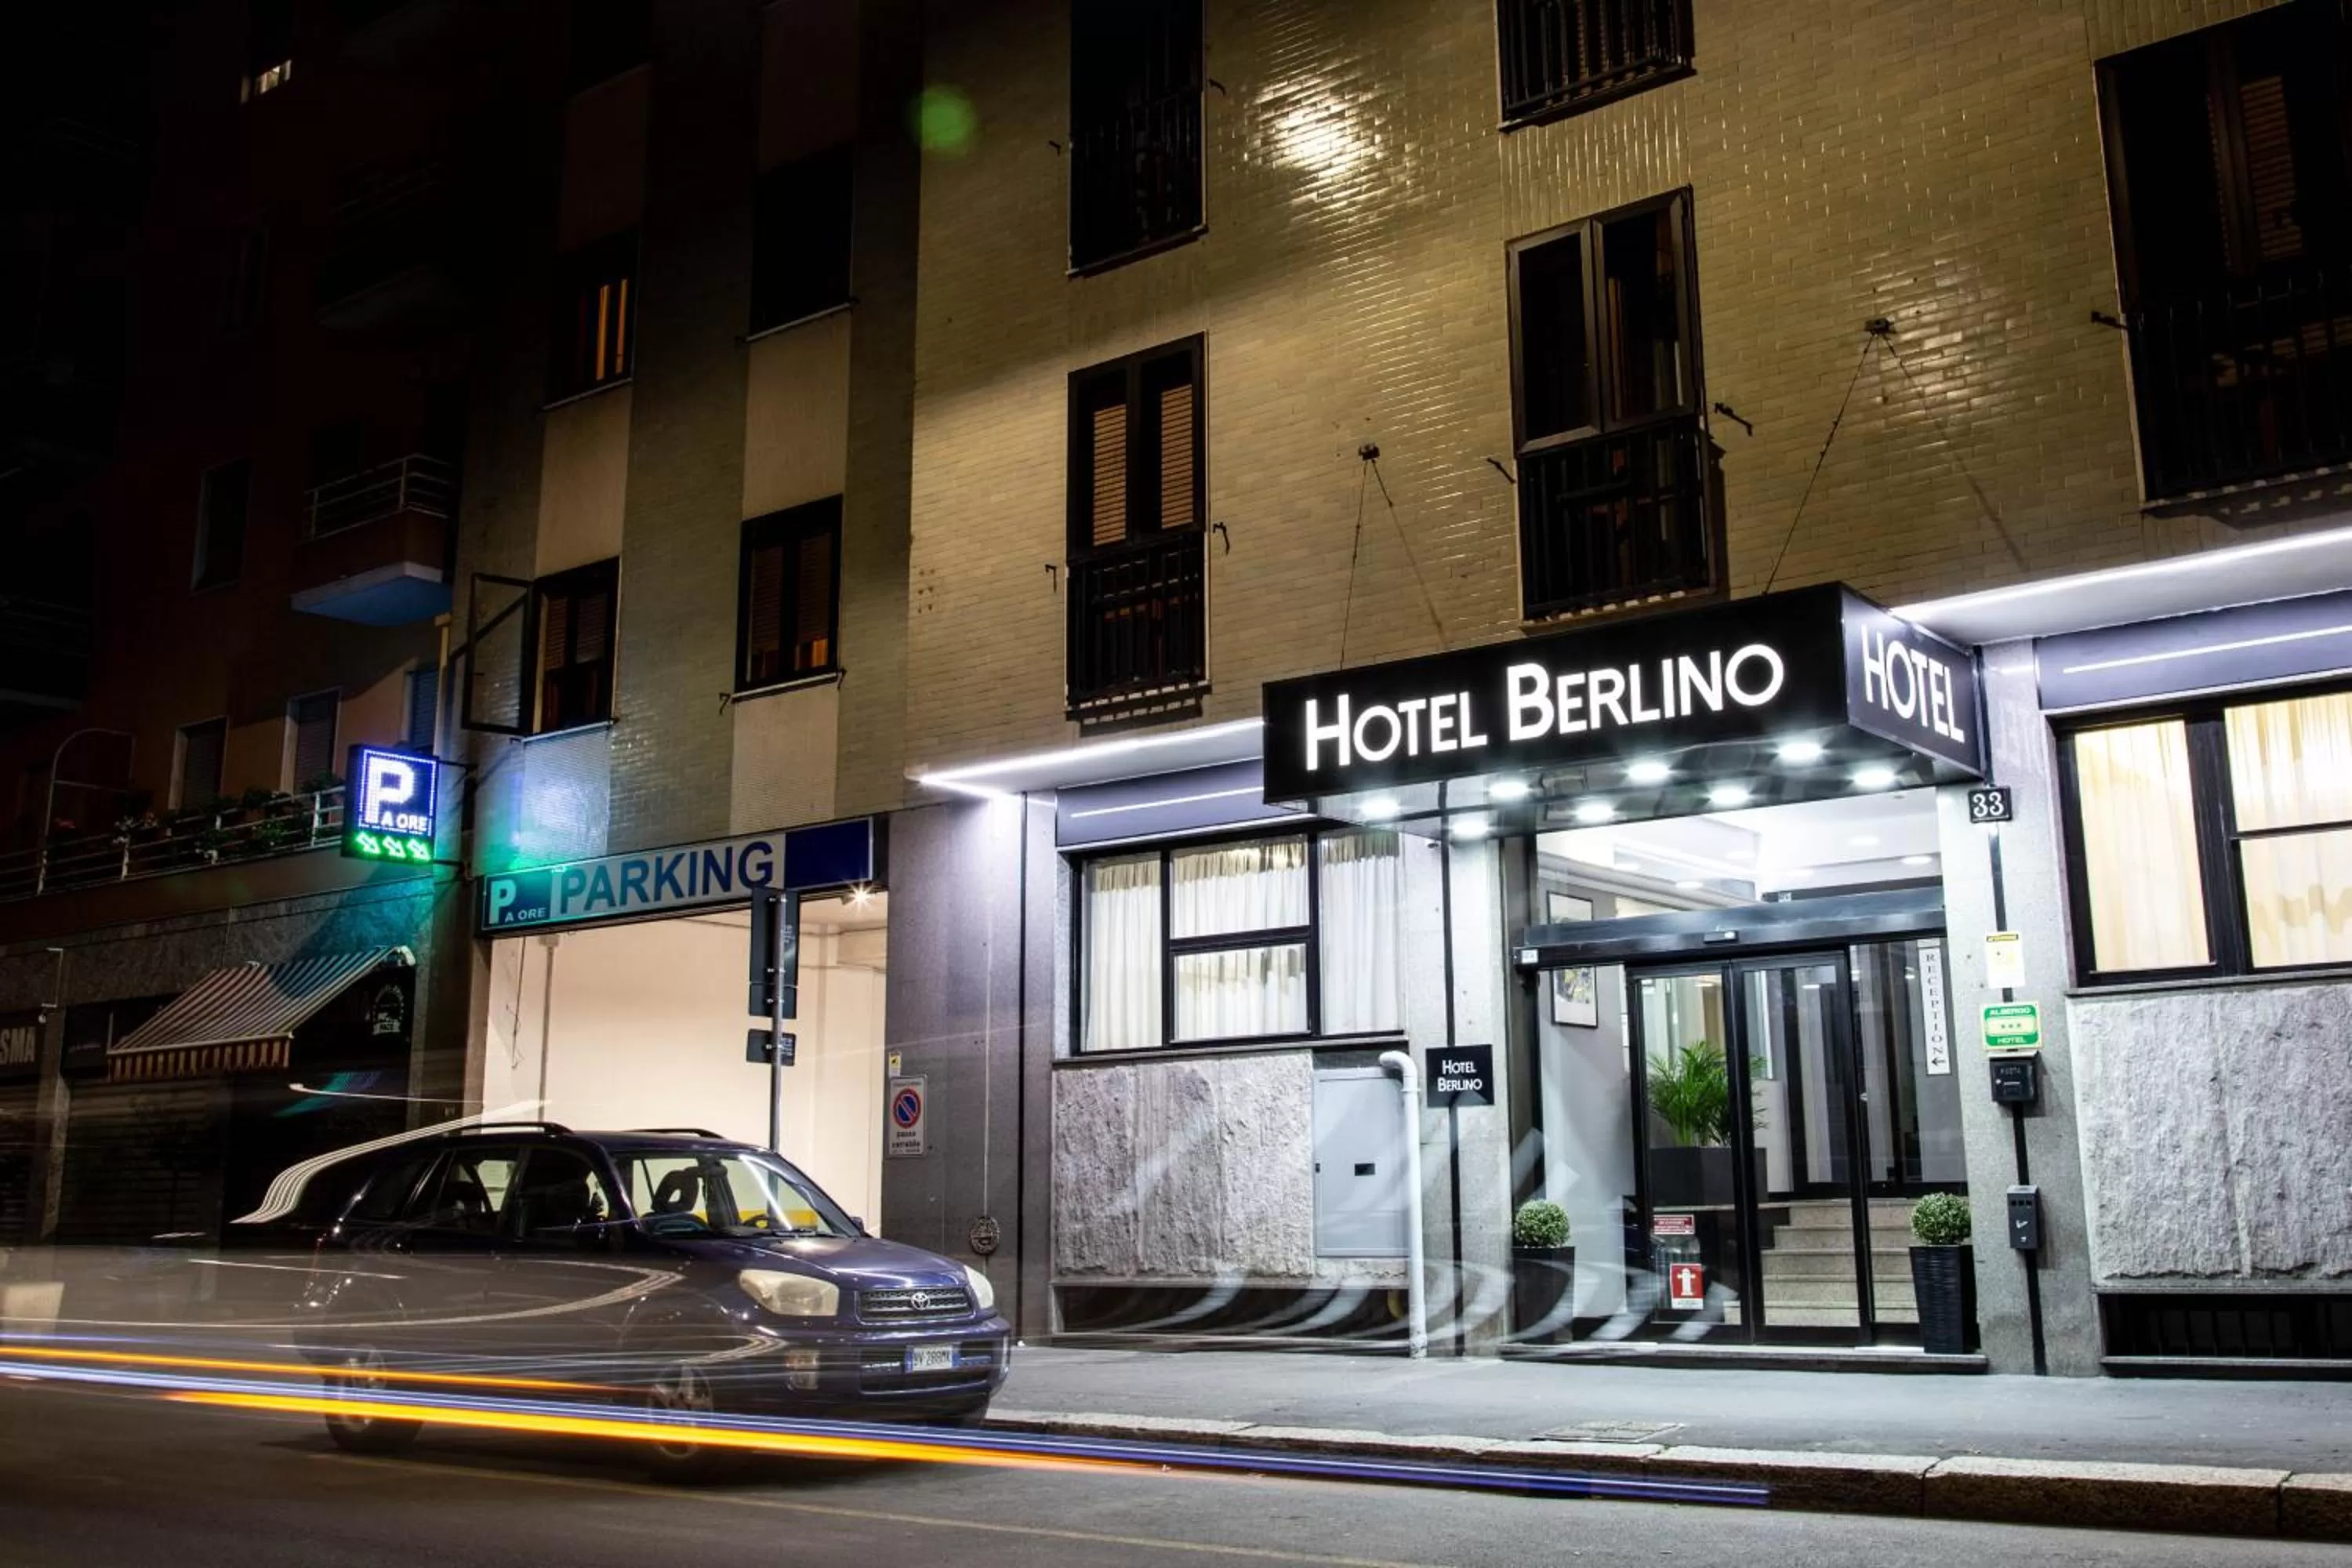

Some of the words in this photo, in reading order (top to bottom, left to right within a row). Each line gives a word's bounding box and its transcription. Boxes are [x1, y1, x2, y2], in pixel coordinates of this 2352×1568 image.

[1861, 624, 1965, 743] HOTEL
[1305, 693, 1488, 771] HOTEL
[1507, 643, 1784, 742] BERLINO
[365, 757, 415, 824] P
[1973, 791, 2005, 818] 33
[380, 811, 394, 827] A
[396, 813, 427, 831] ORE
[559, 840, 773, 914] PARKING
[489, 879, 516, 924] P
[504, 913, 514, 923] A
[517, 907, 546, 921] ORE
[1926, 953, 1944, 1054] RECEPTION
[1997, 1036, 2027, 1045] HOTEL
[1437, 1076, 1483, 1092] BERLINO
[1442, 1059, 1477, 1074] HOTEL
